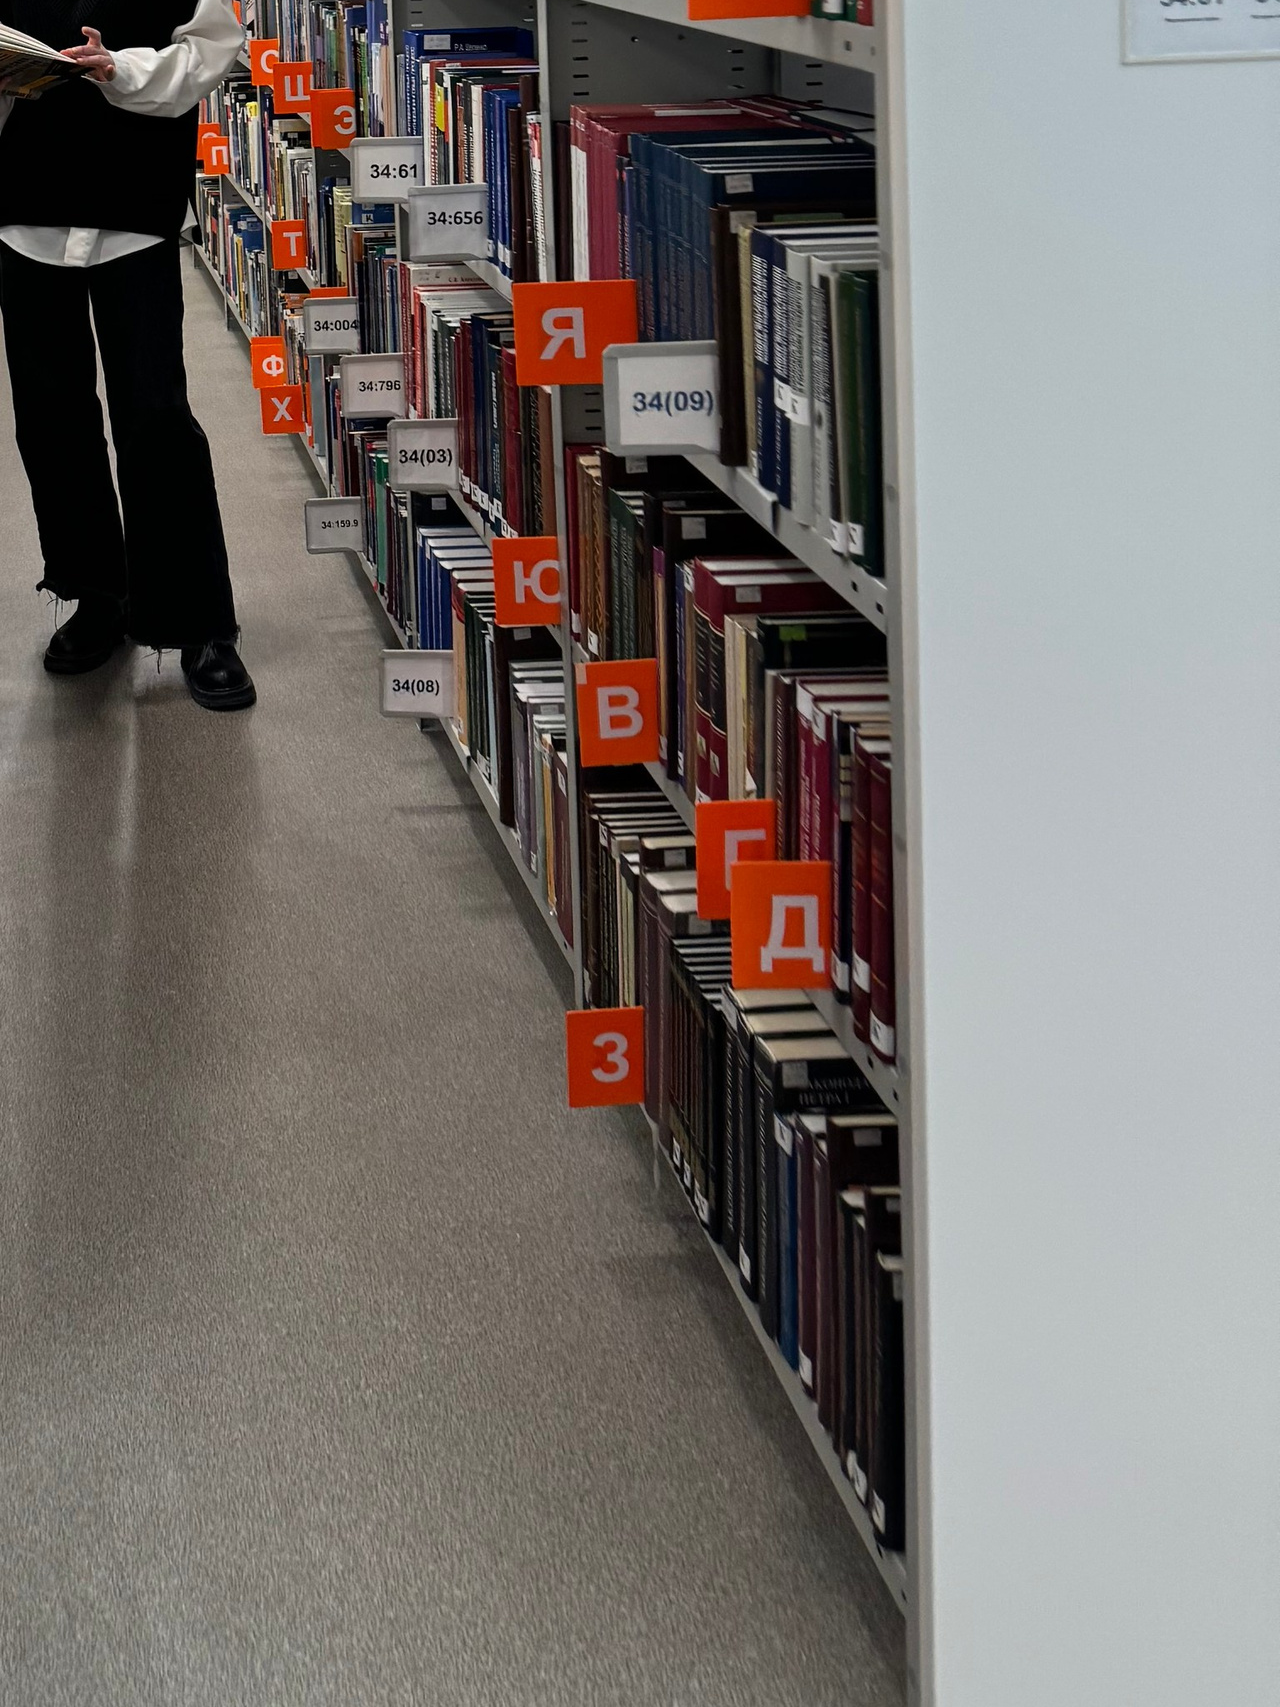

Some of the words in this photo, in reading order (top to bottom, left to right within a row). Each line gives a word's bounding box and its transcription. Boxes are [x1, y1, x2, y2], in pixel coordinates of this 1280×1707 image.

[333, 105, 356, 135] Э
[211, 146, 229, 166] П
[370, 163, 418, 179] 34:61
[427, 211, 483, 225] 34:656
[282, 232, 302, 256] Т
[313, 319, 359, 332] 34:004
[539, 307, 586, 360] Я
[261, 355, 284, 378] Ф
[358, 380, 402, 393] 34:796
[271, 396, 294, 422] Х
[632, 390, 714, 418] 34(09)
[398, 446, 454, 469] 34(03)
[320, 519, 360, 531] 34:159.9
[514, 560, 560, 604] Ю
[391, 677, 441, 698] 34(08)
[596, 686, 644, 740] В
[760, 894, 826, 973] Д
